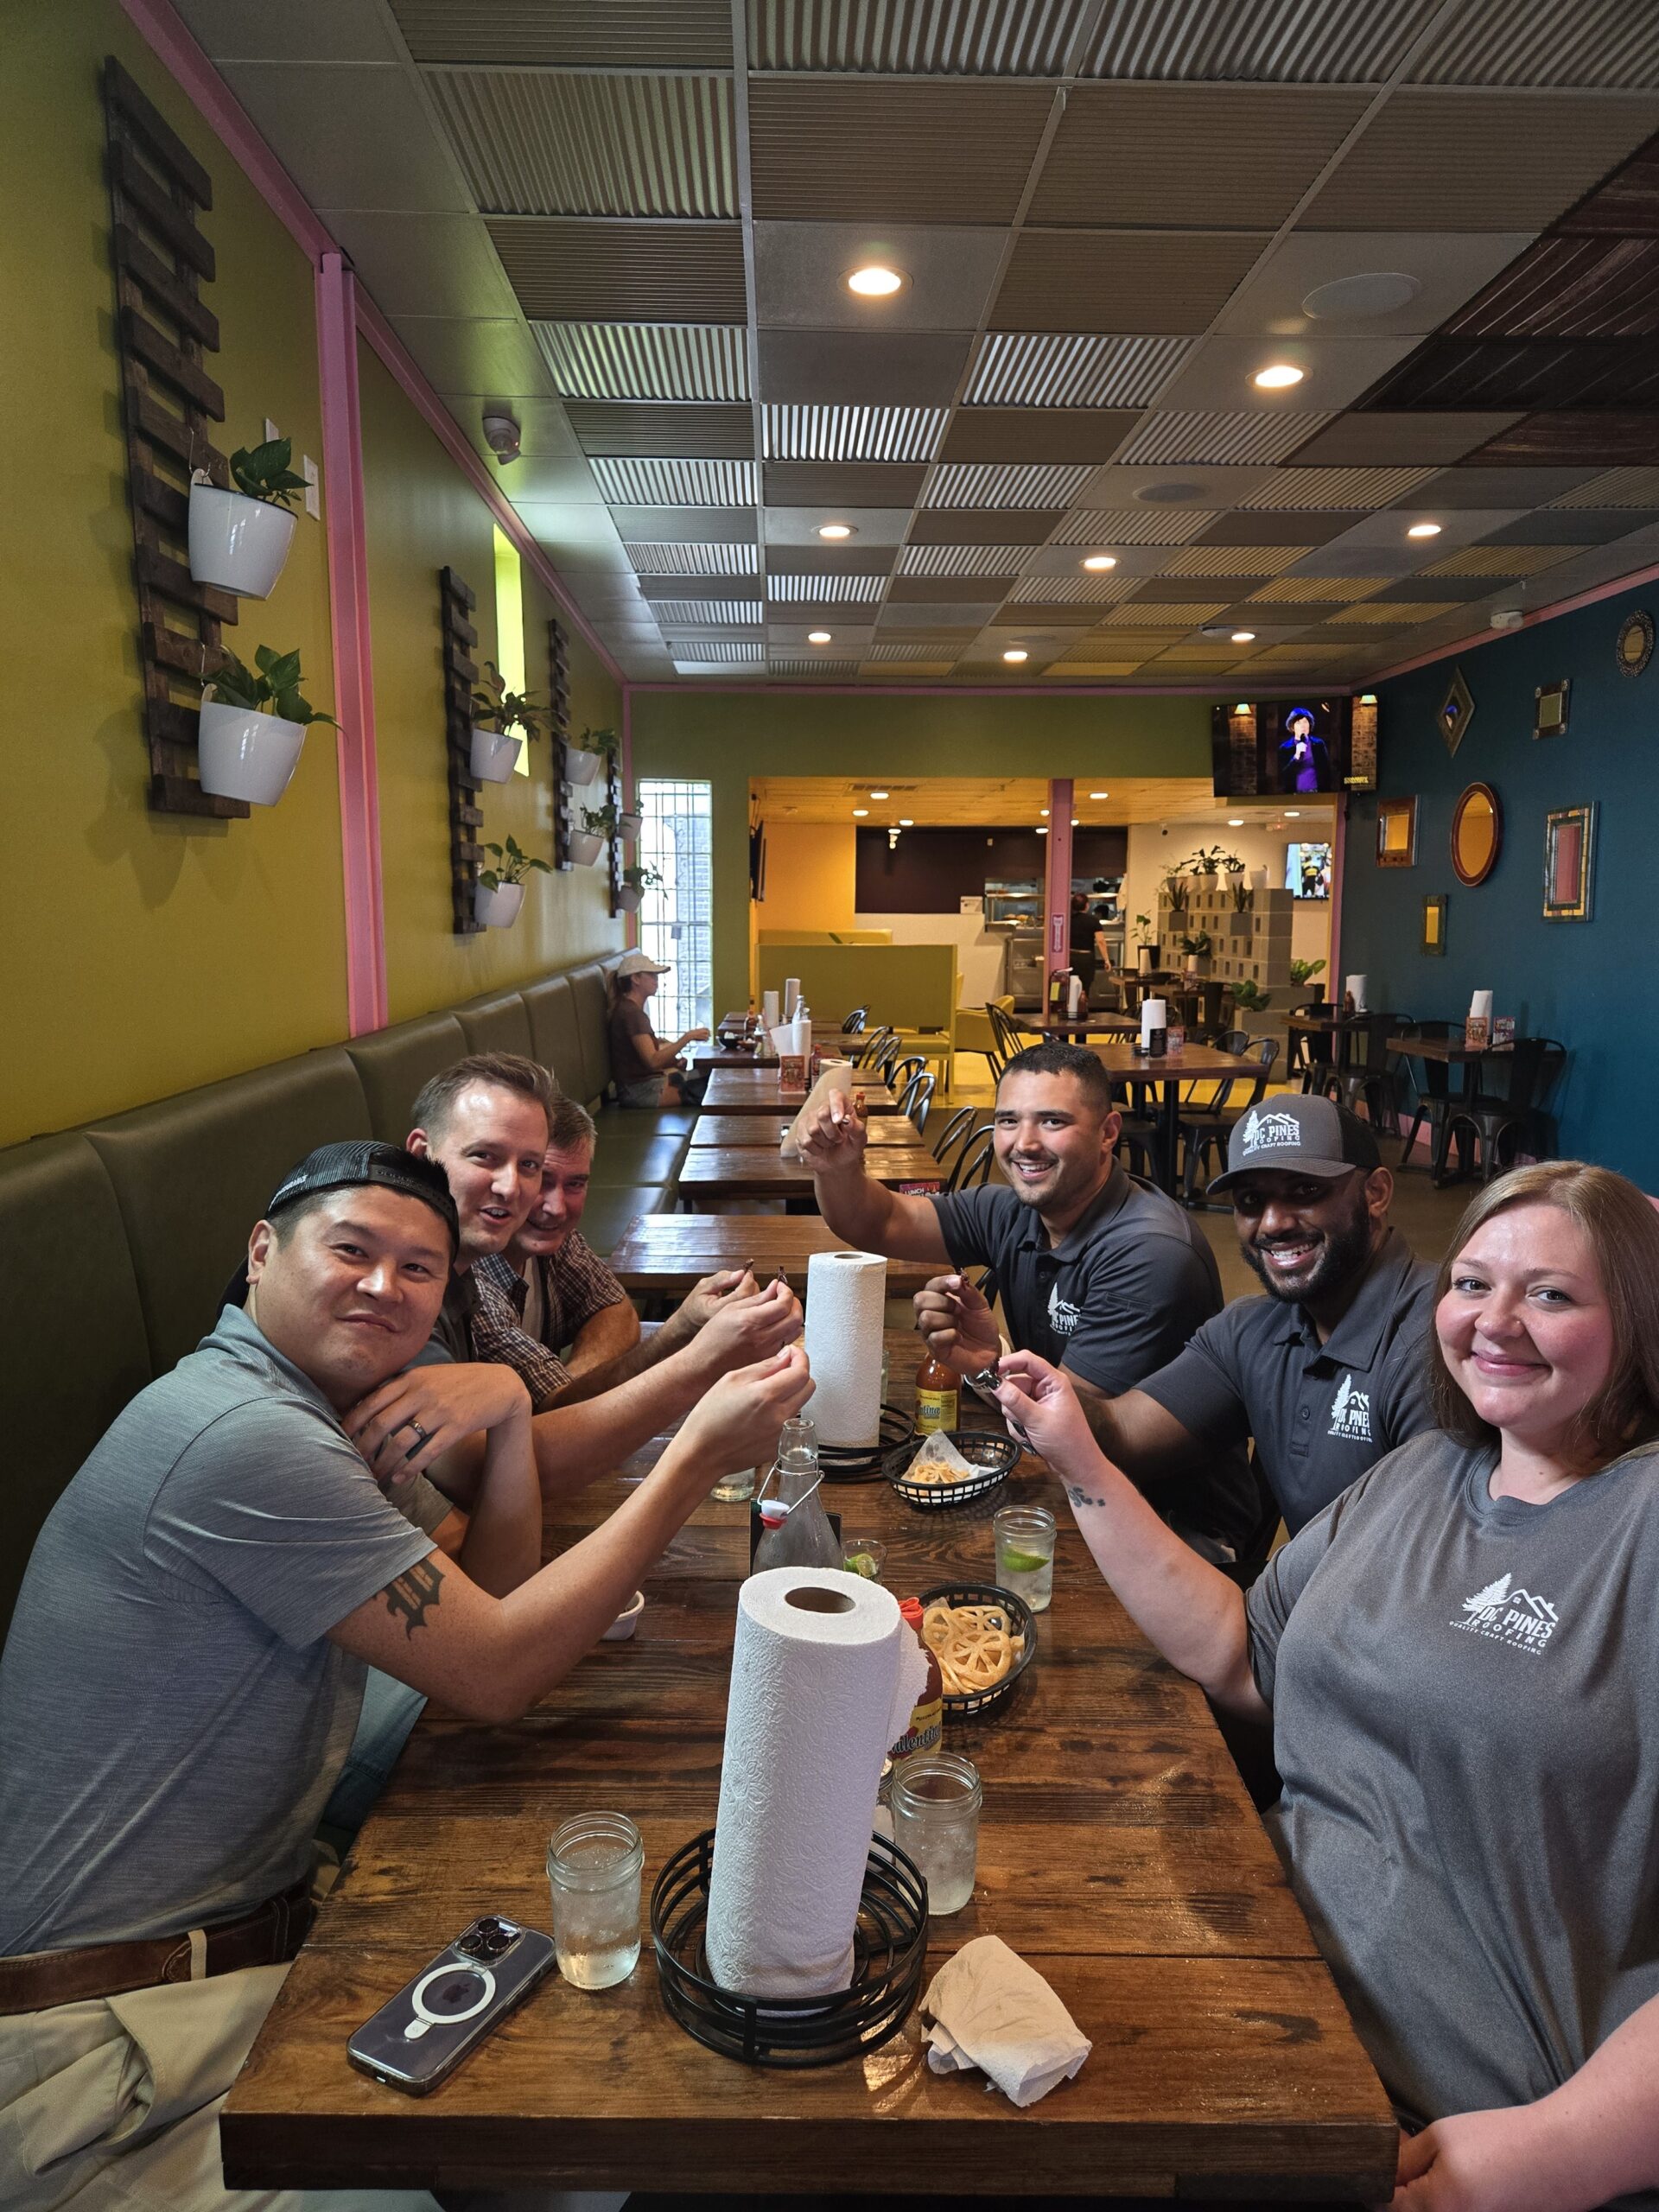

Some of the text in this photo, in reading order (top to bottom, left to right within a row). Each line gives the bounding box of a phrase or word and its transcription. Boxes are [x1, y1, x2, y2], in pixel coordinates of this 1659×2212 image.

[1268, 1124, 1300, 1136] PINES
[1471, 1618, 1548, 1648] ROOFING
[1478, 1605, 1556, 1639] DC PINES
[1449, 1621, 1541, 1656] QUALITY CRAFT ROOFING
